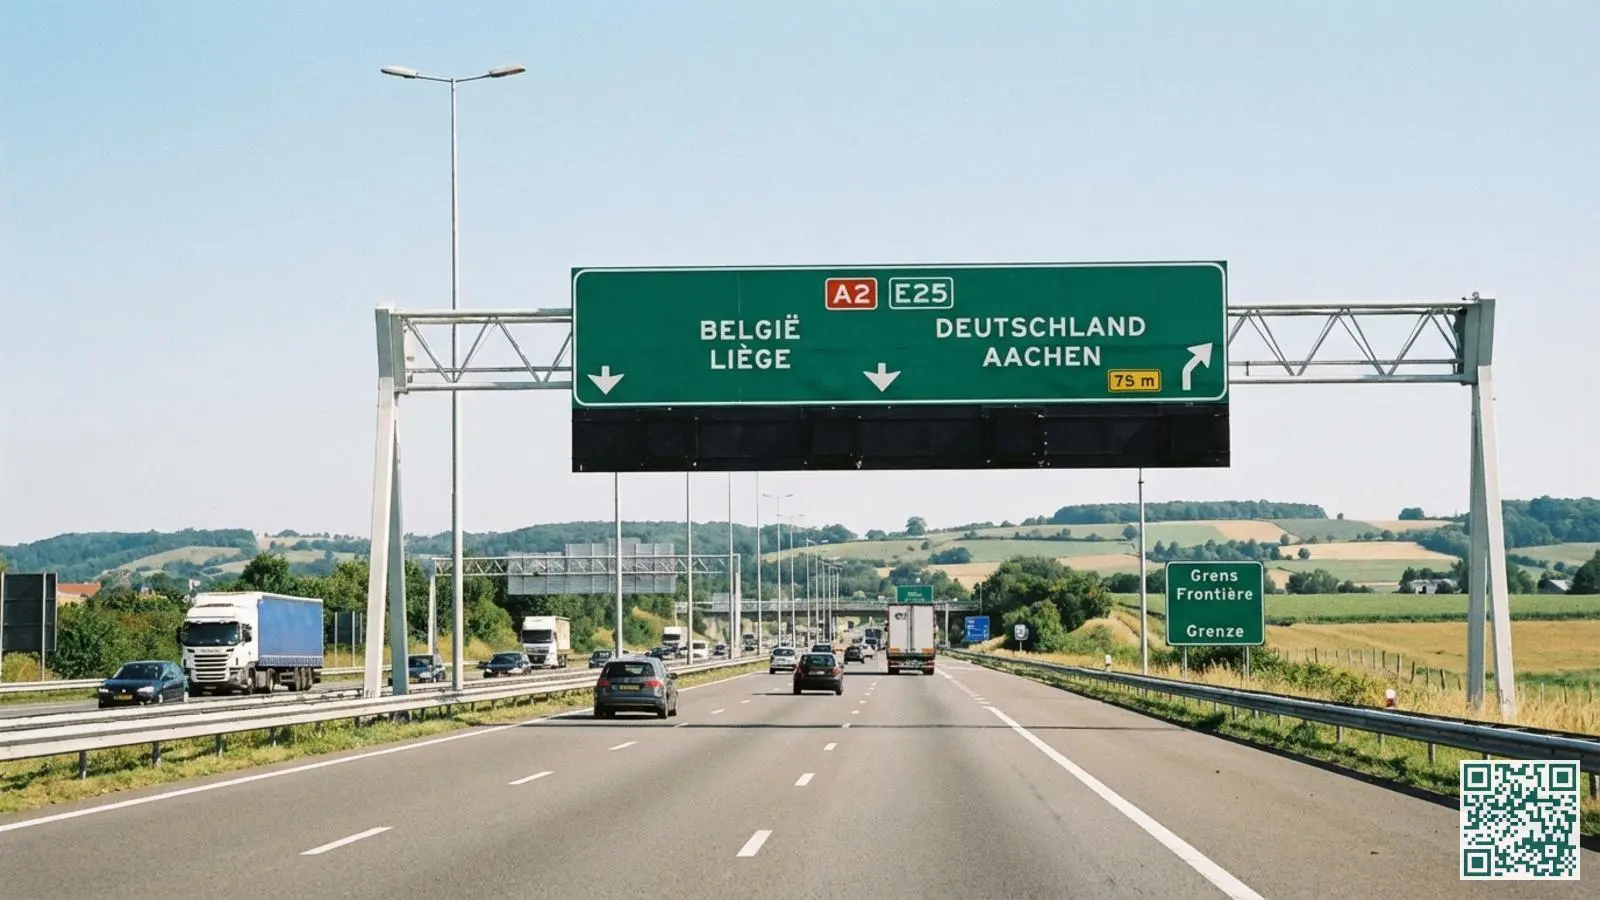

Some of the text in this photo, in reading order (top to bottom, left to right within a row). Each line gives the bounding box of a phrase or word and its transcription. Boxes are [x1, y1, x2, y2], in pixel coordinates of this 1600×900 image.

[833, 284, 870, 304] A2
[895, 283, 947, 303] E25
[700, 314, 800, 340] BELGIË
[936, 316, 1146, 338] DEUTSCHLAND
[711, 343, 791, 369] LIÈGE
[982, 346, 1101, 367] AACHEN
[1141, 376, 1155, 387] m
[1191, 569, 1238, 582] Grens
[1177, 587, 1253, 600] Frontière
[1186, 624, 1244, 637] Grenze
